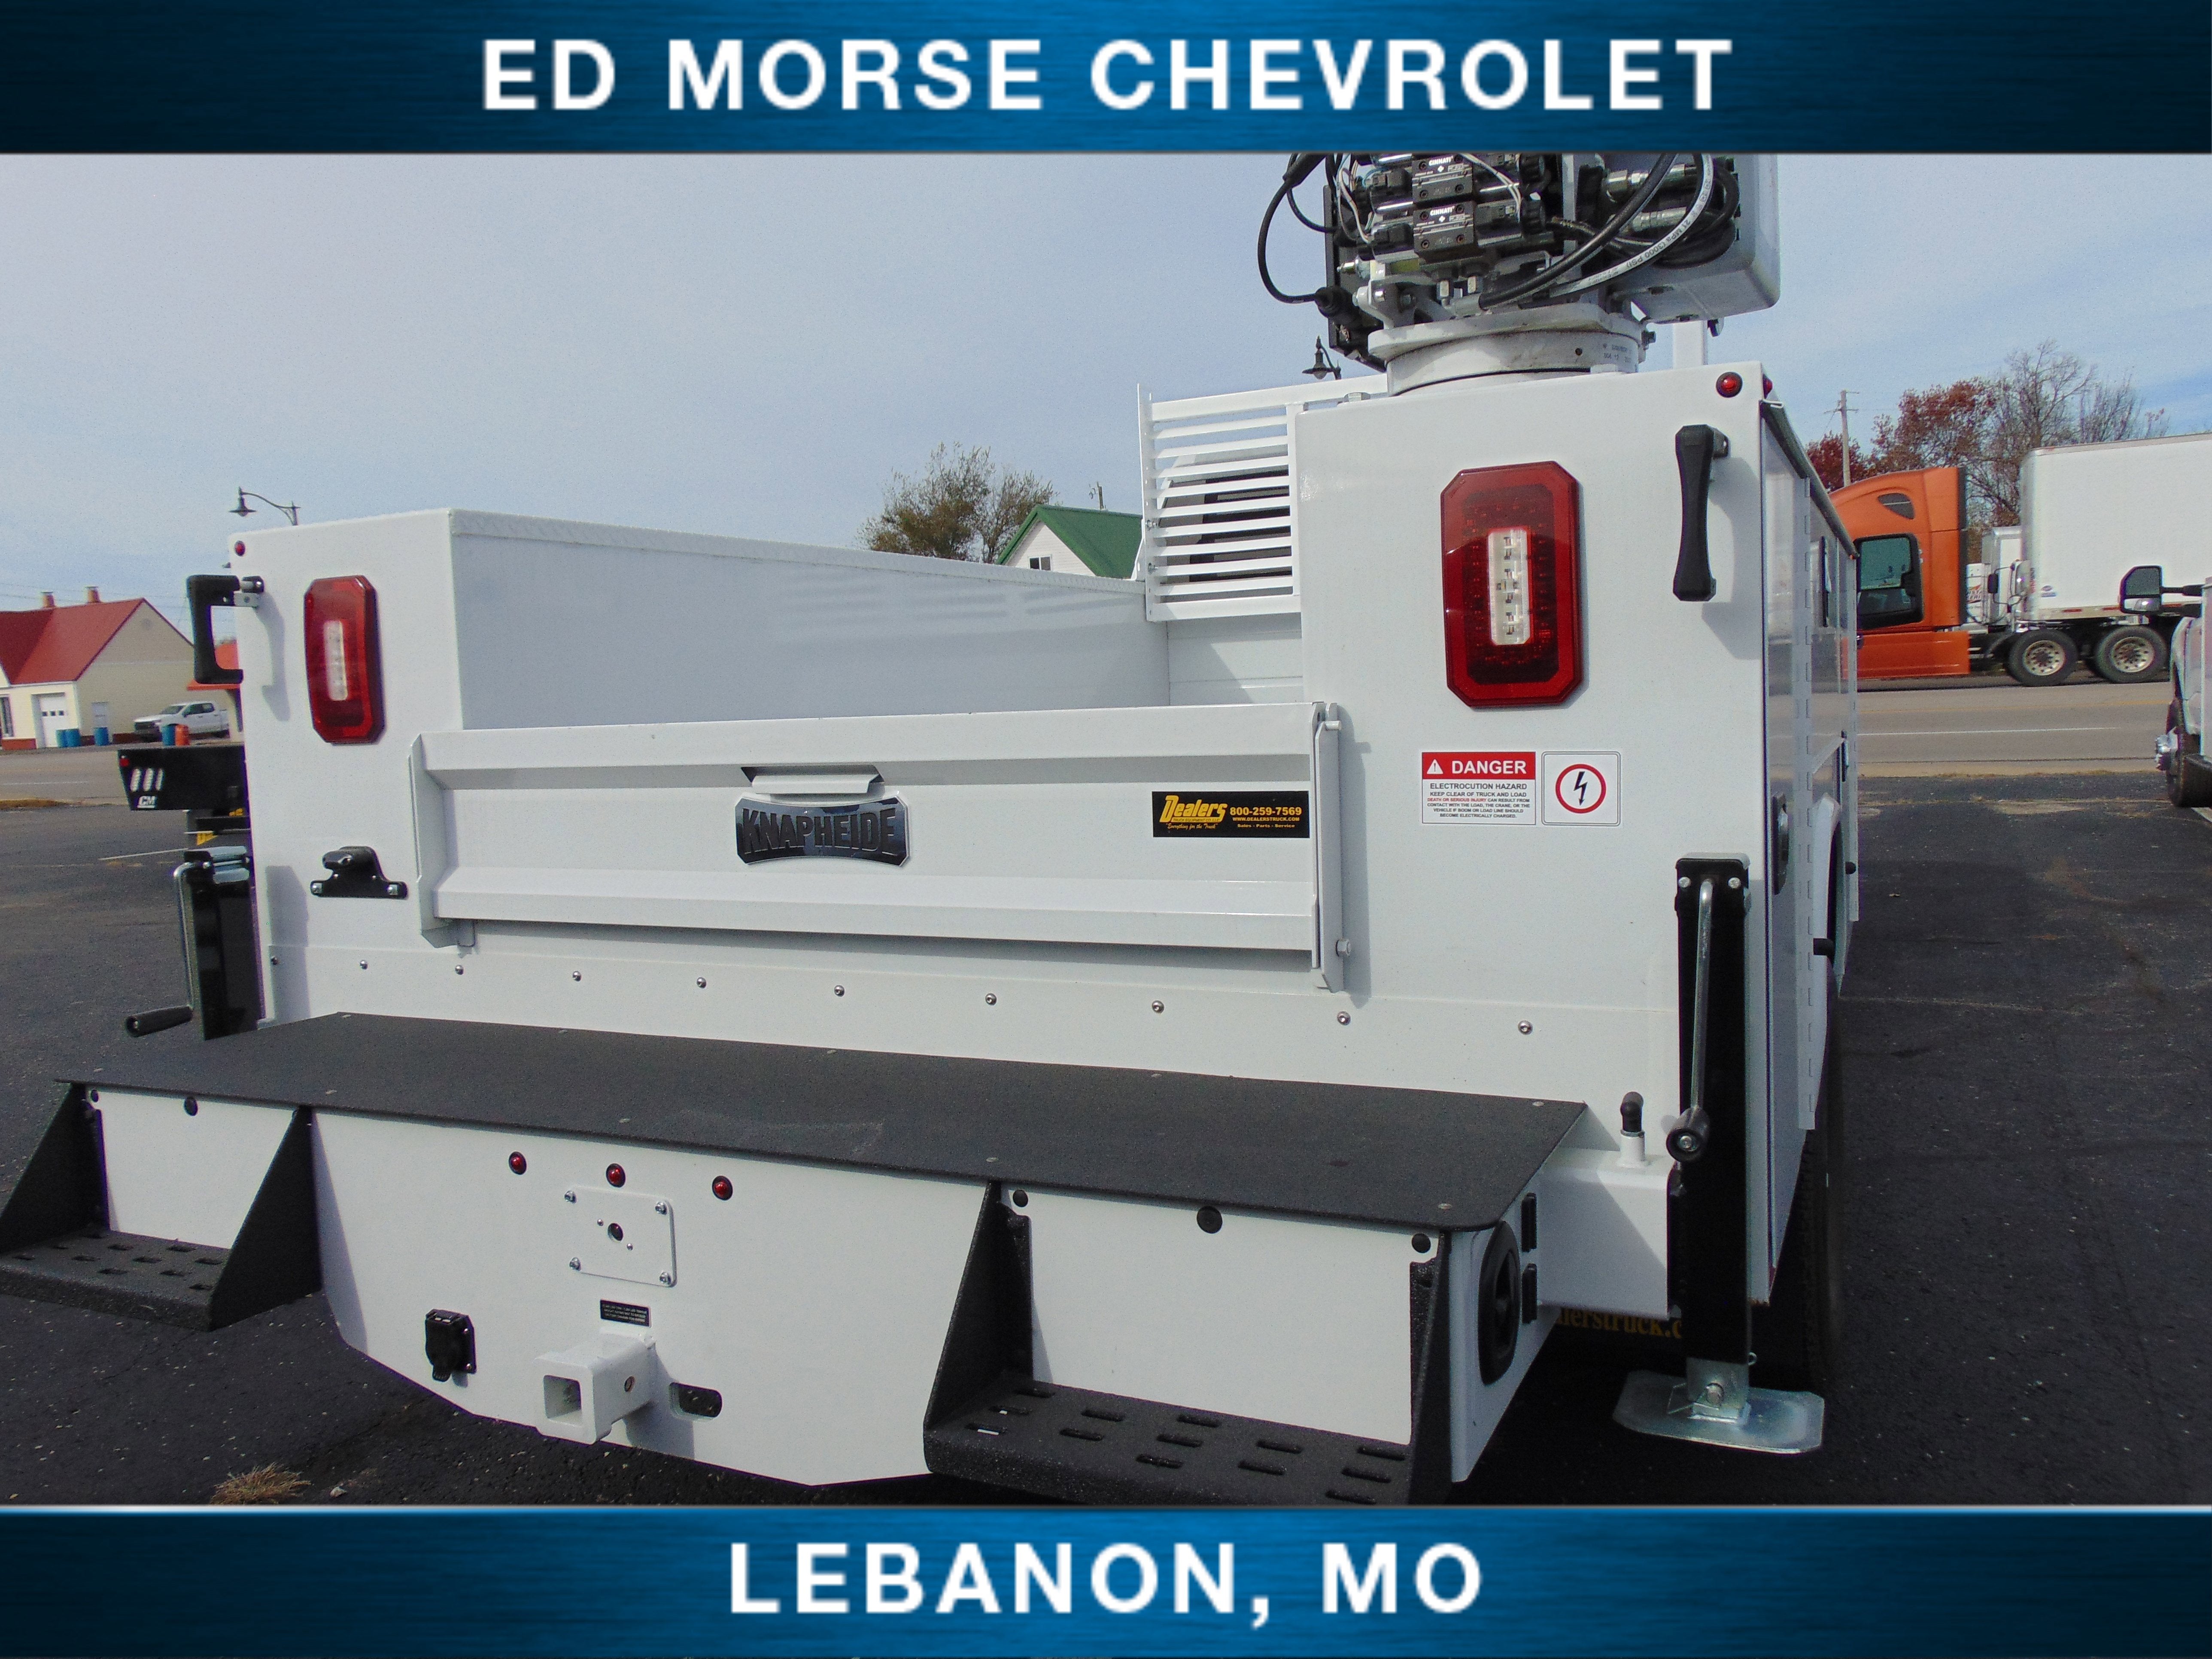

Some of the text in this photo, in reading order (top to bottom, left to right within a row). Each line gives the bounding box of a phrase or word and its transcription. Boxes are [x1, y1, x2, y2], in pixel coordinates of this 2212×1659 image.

[1644, 242, 1666, 258] (3000
[1626, 256, 1643, 268] PSI)
[1452, 760, 1527, 774] DANGER
[1159, 795, 1228, 823] Dealers
[1230, 807, 1302, 816] 800-259-7569
[742, 807, 899, 857] KNAPHEIDE
